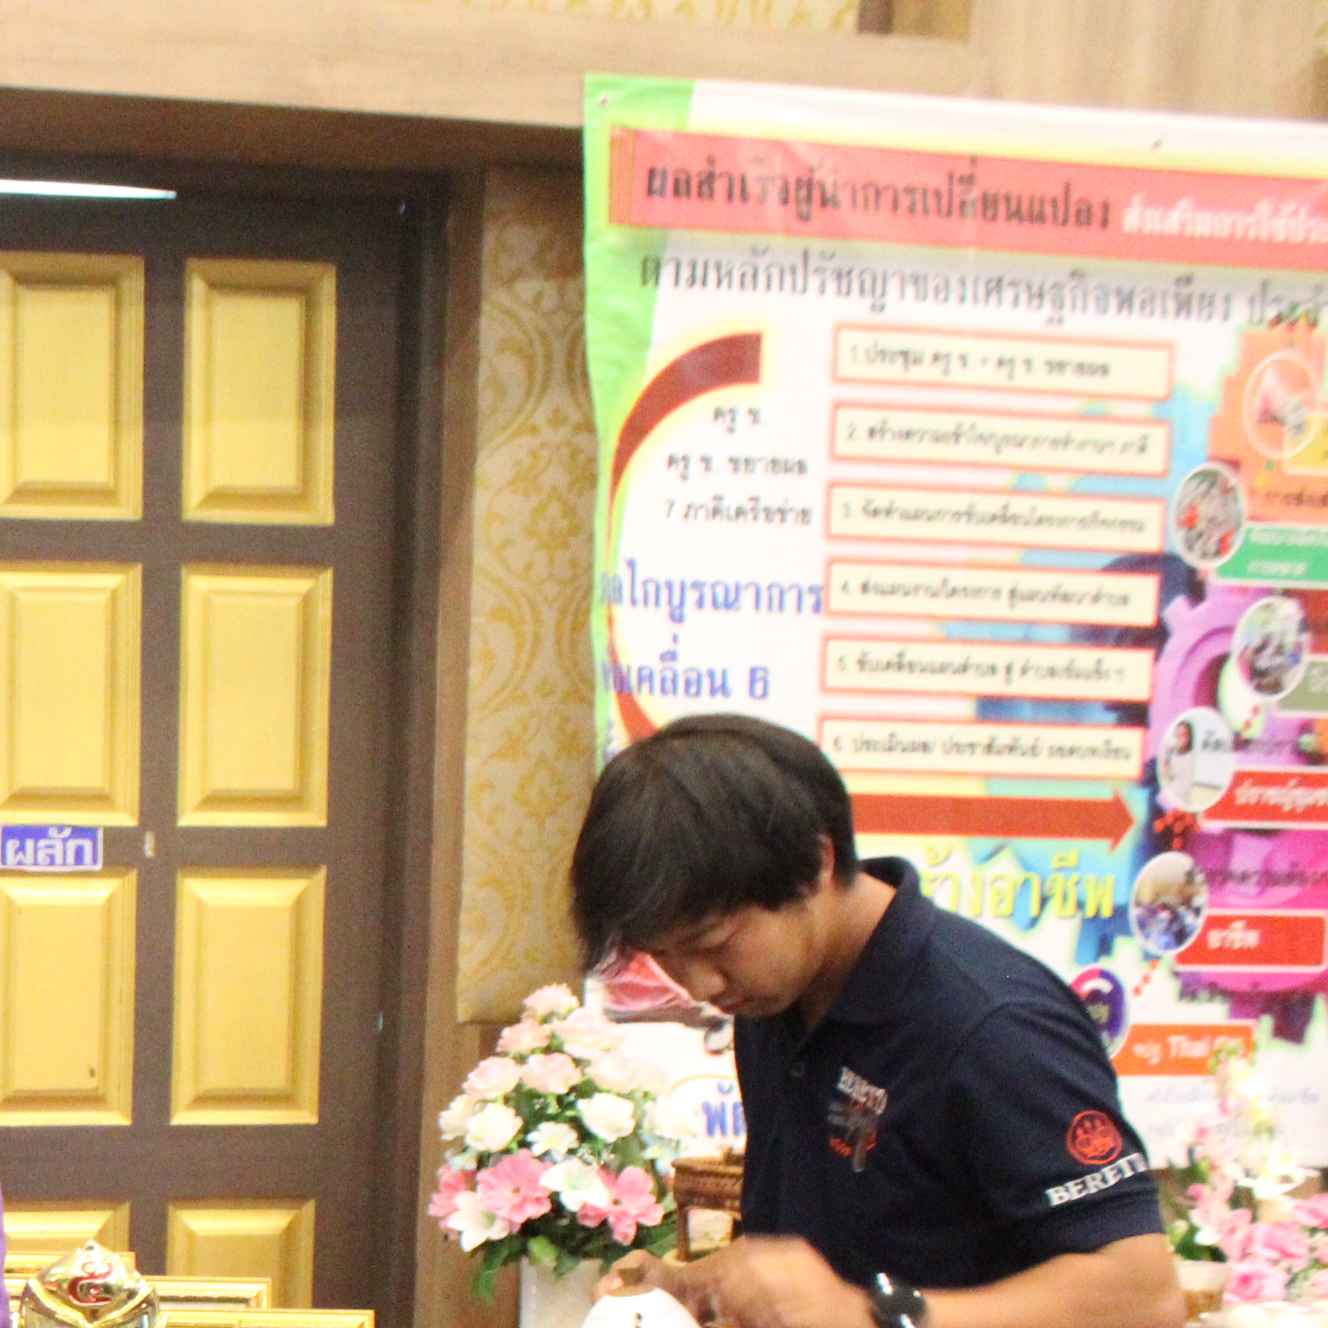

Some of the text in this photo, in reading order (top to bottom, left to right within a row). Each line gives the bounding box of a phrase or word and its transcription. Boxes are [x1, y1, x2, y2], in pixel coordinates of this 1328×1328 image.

[5, 826, 94, 866] ผลัก
[919, 845, 1116, 919] ร้างอาชีพ
